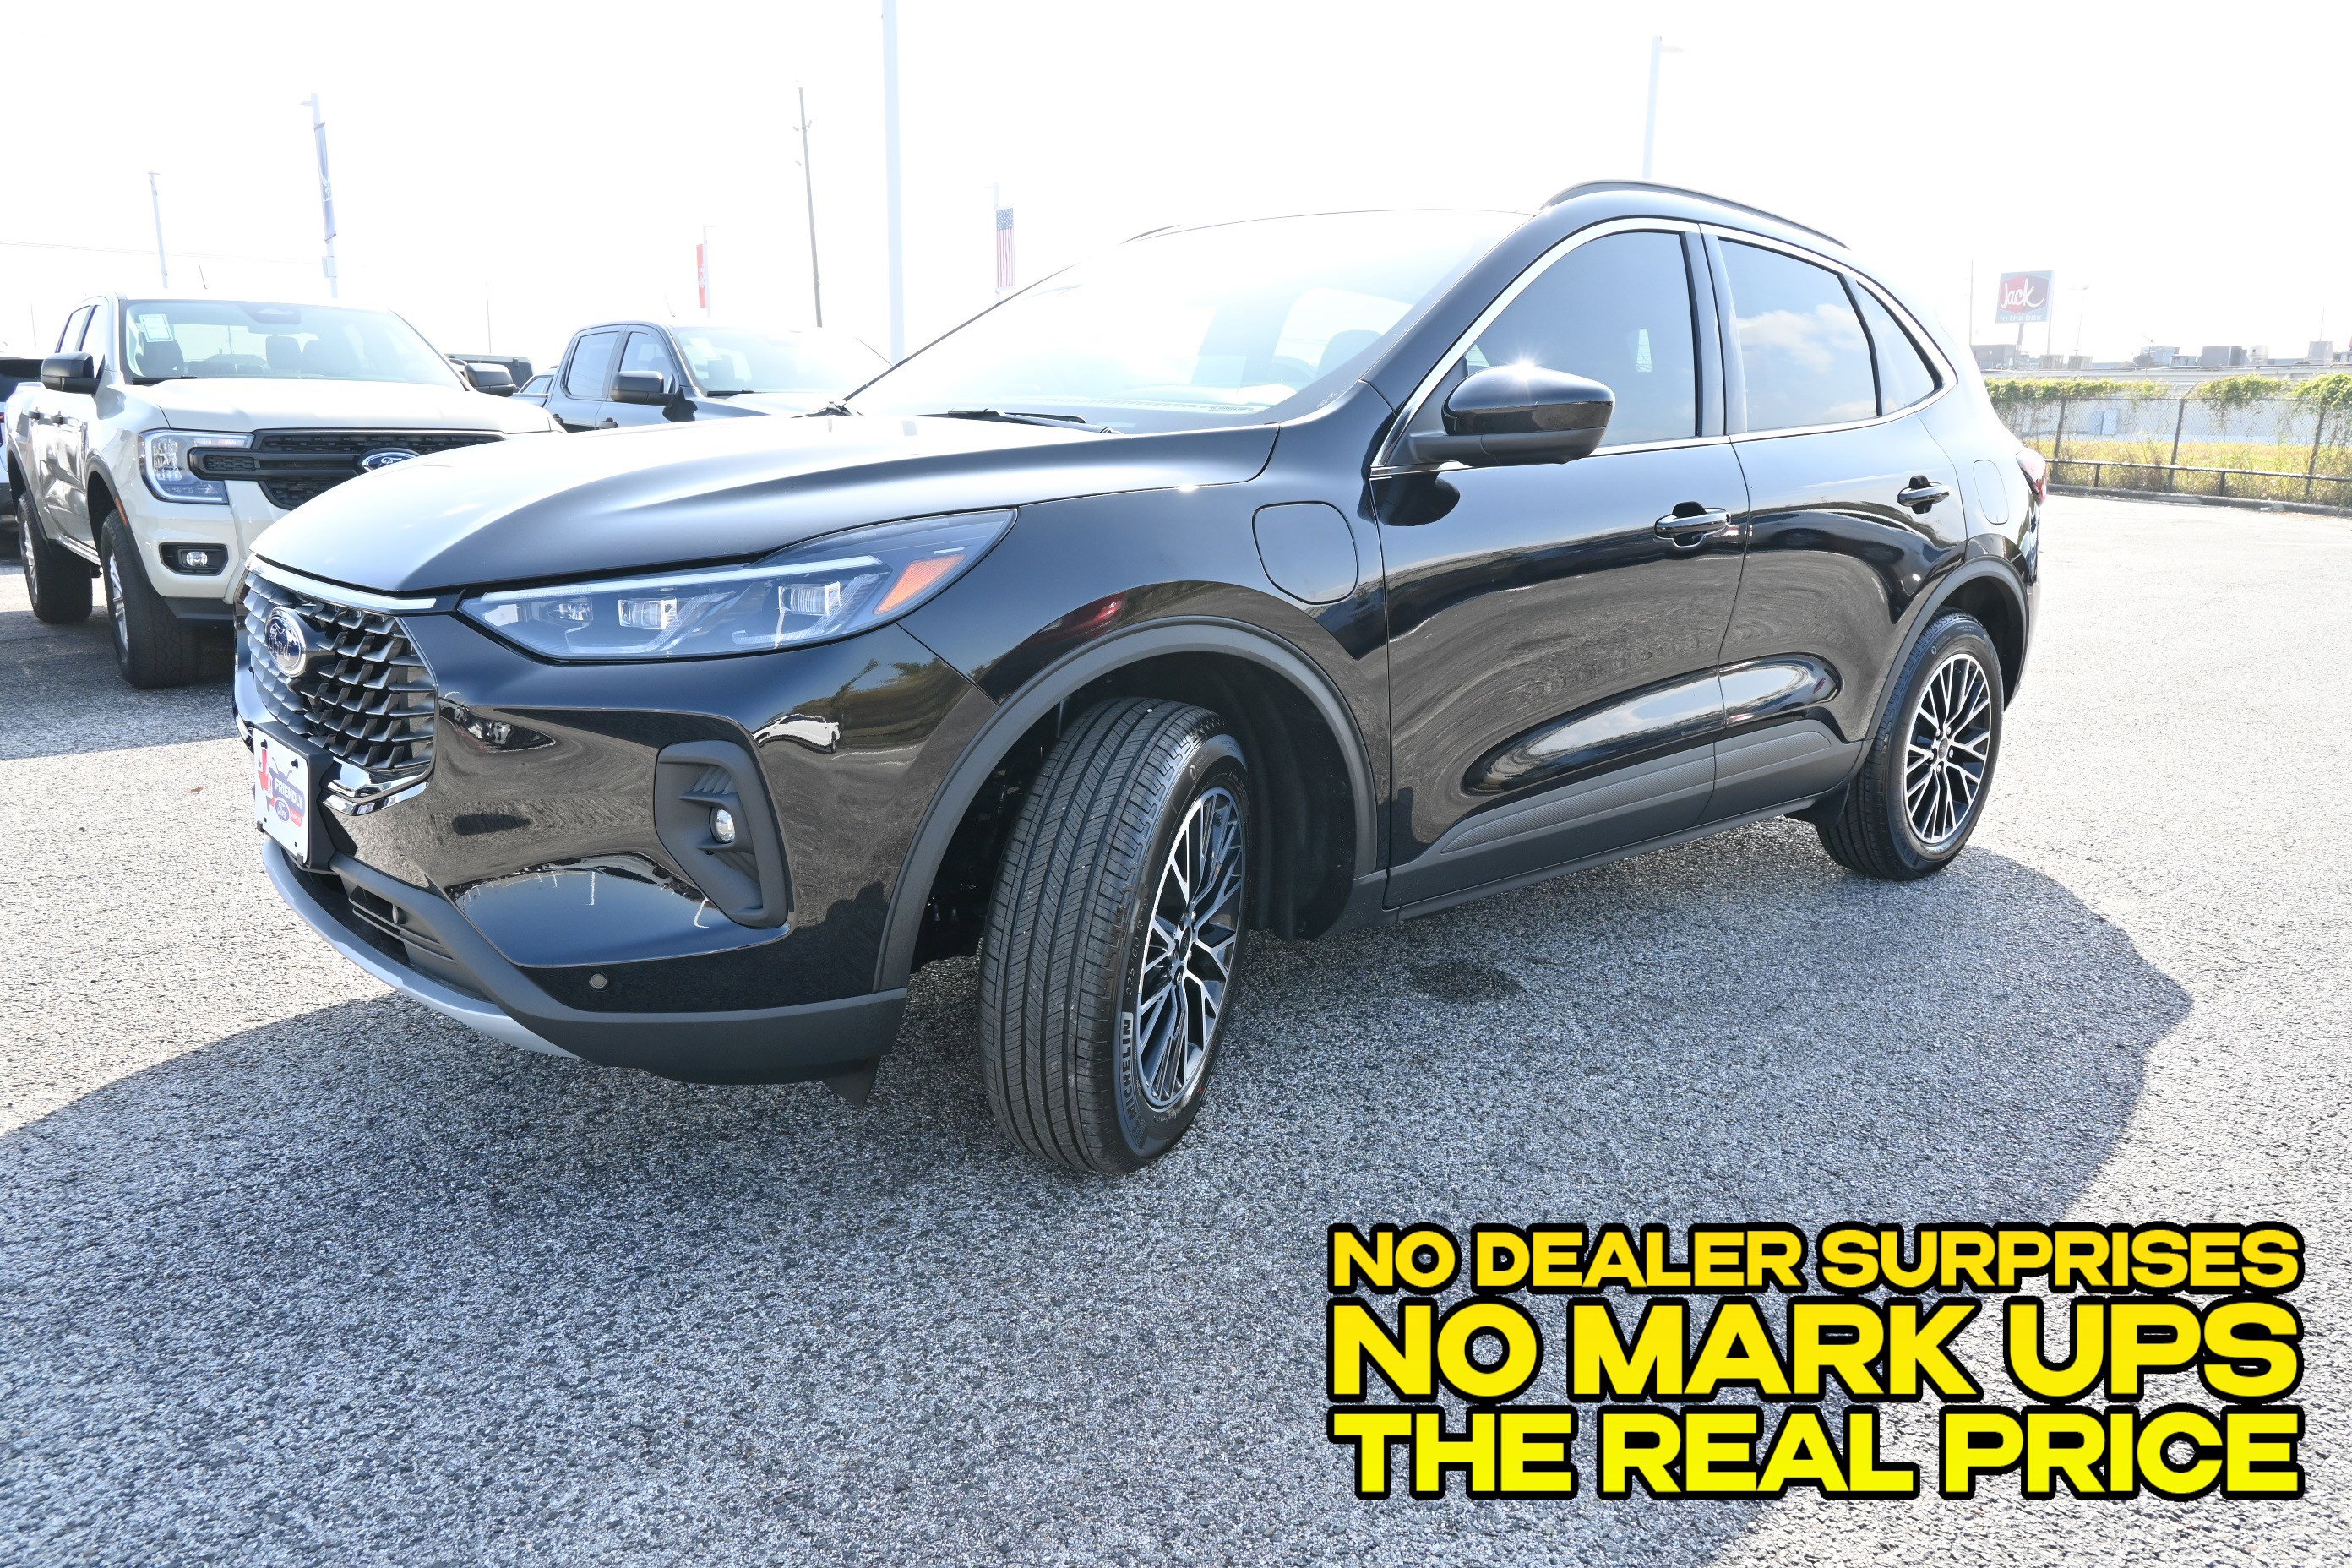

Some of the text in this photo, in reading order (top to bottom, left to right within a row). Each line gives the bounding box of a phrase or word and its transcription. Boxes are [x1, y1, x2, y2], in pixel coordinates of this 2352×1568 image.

[2001, 278, 2044, 308] Jack
[270, 622, 291, 661] Ford
[275, 778, 303, 808] FRIENDLY
[1122, 1019, 1138, 1121] MICHELIN
